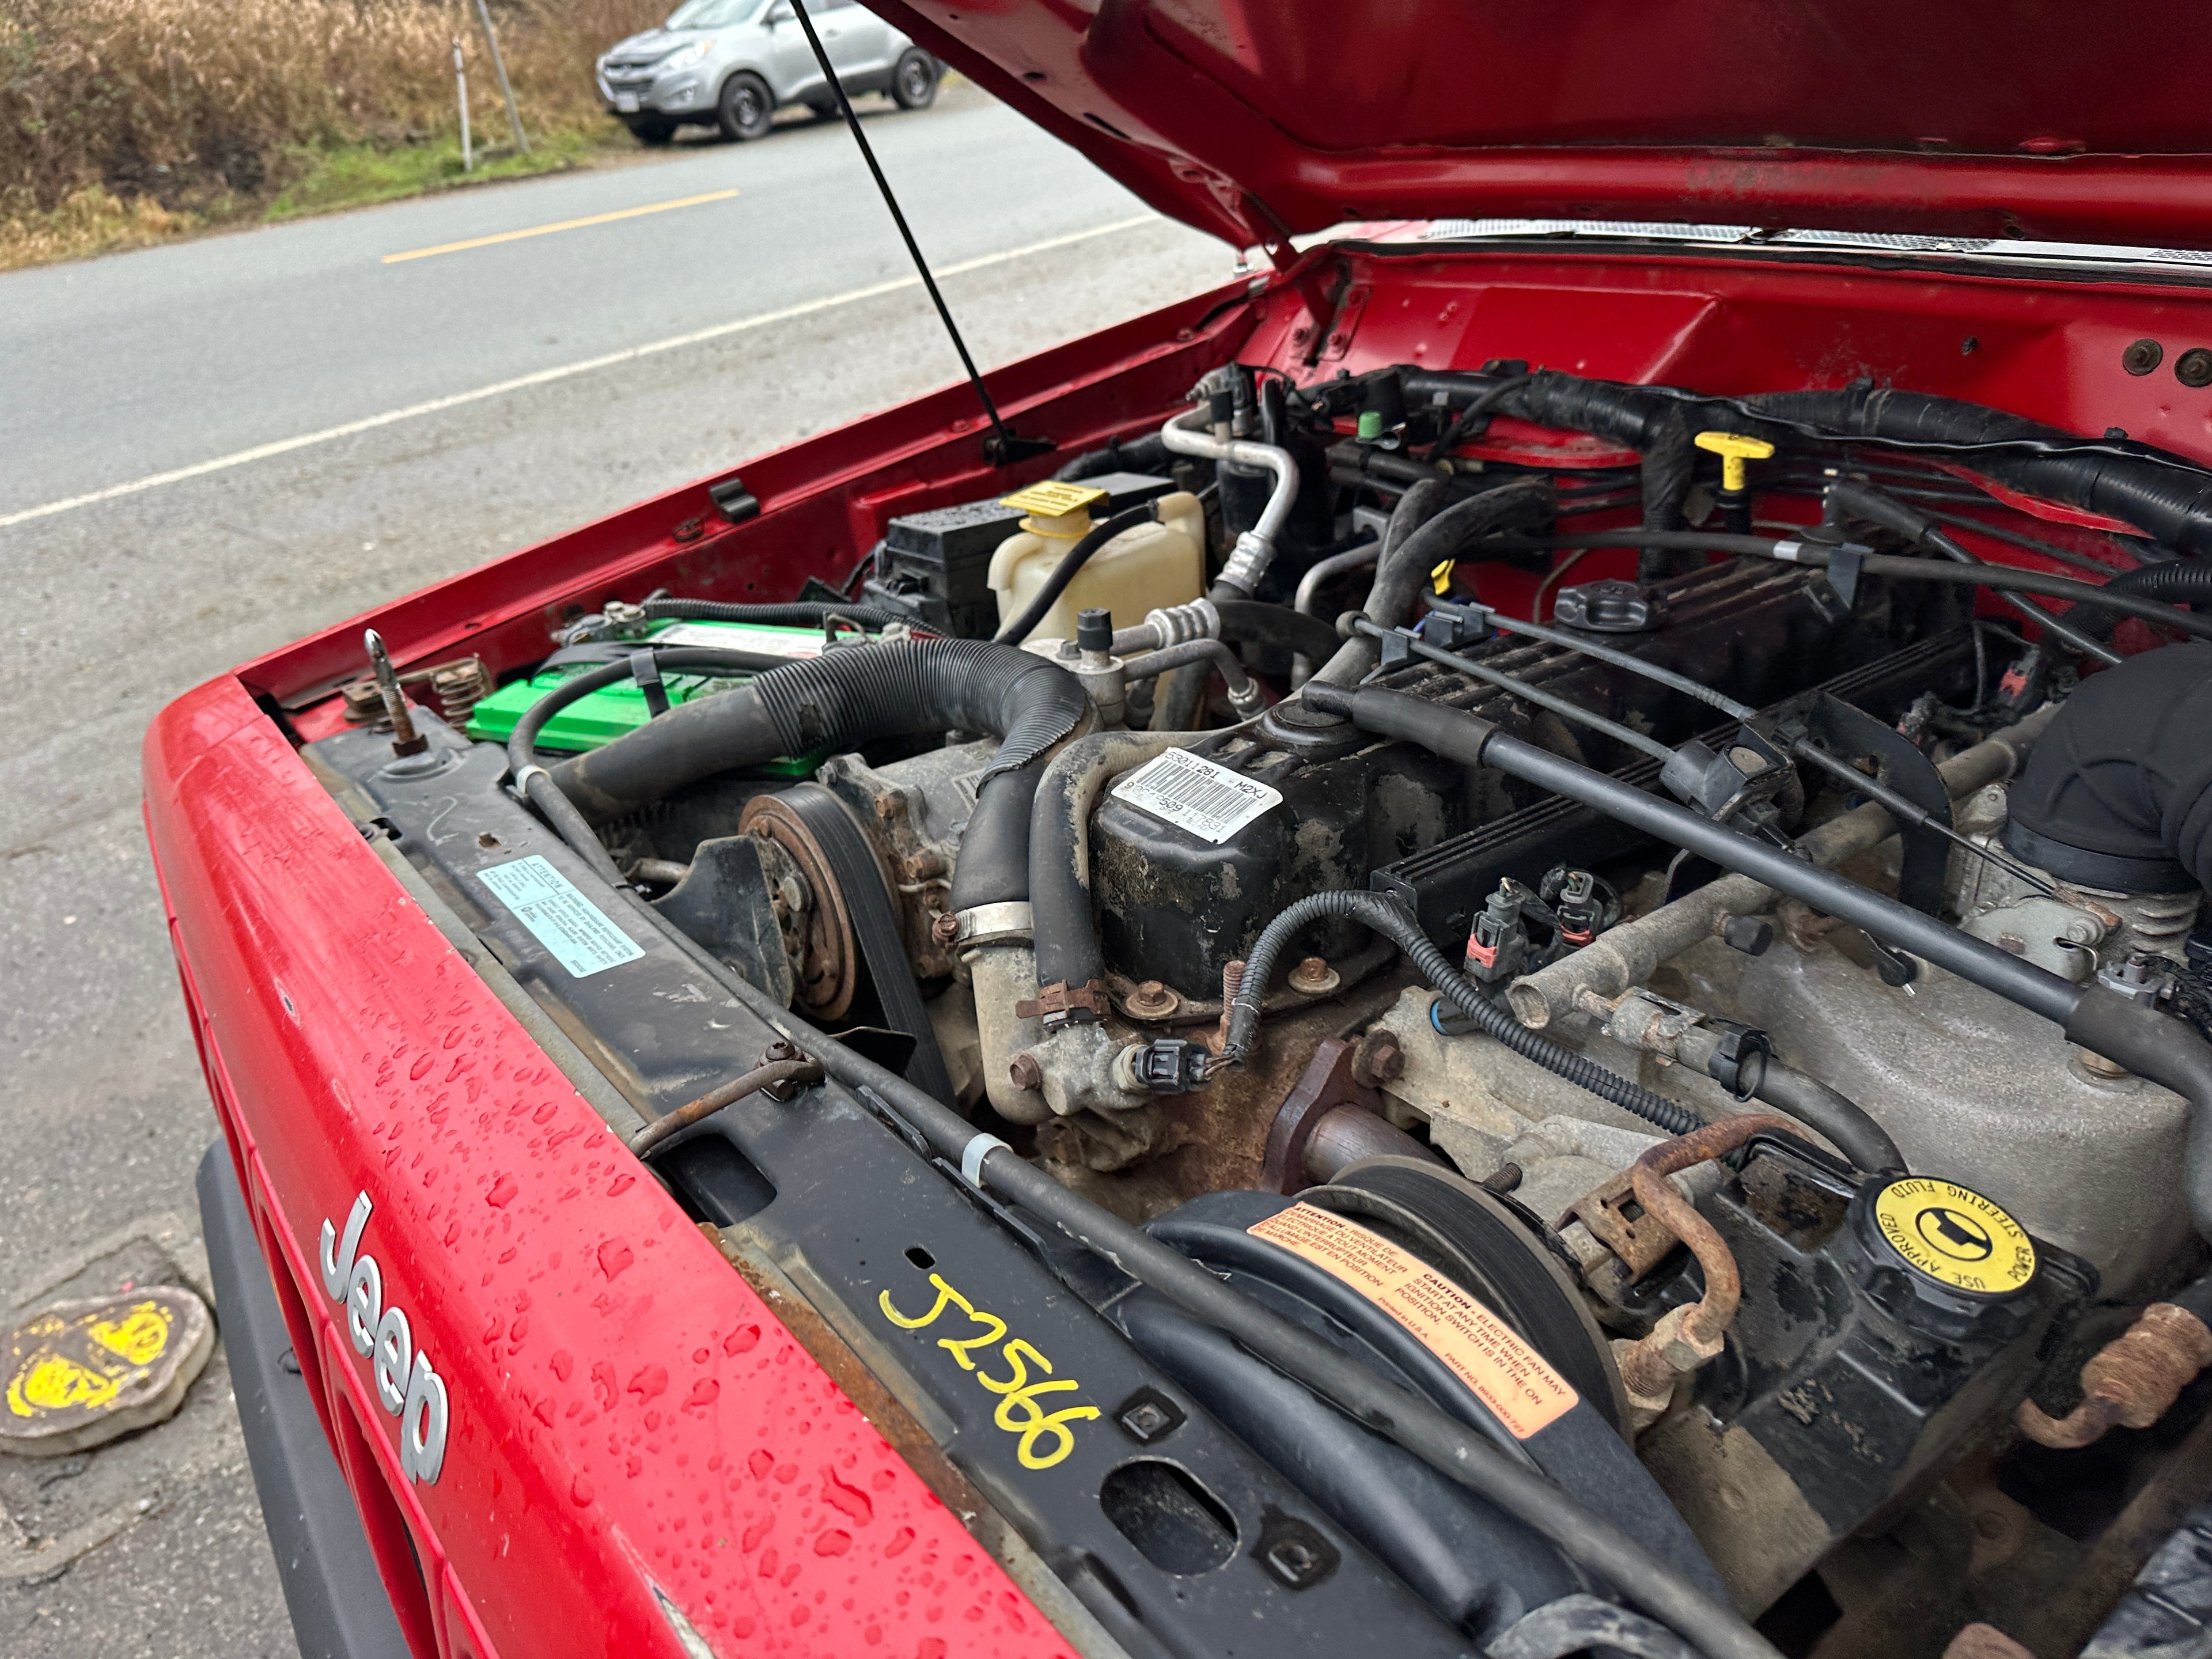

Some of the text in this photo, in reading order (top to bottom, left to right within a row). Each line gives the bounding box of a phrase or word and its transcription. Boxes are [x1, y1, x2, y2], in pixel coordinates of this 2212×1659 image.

[1165, 752, 1268, 800] 53011281 M2XJ
[532, 862, 563, 888] ATTENTION
[1278, 1214, 1328, 1236] ELECTRIQUE
[1334, 1237, 1358, 1250] TOUT
[1356, 1250, 1397, 1274] MOMENT
[1286, 1210, 1408, 1273] DEMARRAGE DU VENTILATEUR
[1294, 1207, 1345, 1228] ATTENTION
[1350, 1230, 1384, 1248] RISQUE
[1382, 1247, 1399, 1256] DE
[1297, 1229, 1368, 1266] L'INTERRUPTEUR
[1880, 1213, 1986, 1289] USE APPROVED
[1891, 1181, 2032, 1282] POWER STEERING FLUID
[1309, 1242, 1330, 1252] EST
[1326, 1251, 1342, 1260] EN
[1339, 1258, 1384, 1286] POSITION
[1378, 1297, 1402, 1316] Printed
[1413, 1278, 1531, 1377] START AT ANY TIME WHEN
[1423, 1274, 1471, 1309] CAUTION
[1476, 1314, 1524, 1356] ELECTRIC
[1523, 1356, 1545, 1376] FAN
[1543, 1375, 1566, 1395] MAY
[319, 1190, 449, 1485] Jeep
[1404, 1283, 1543, 1405] IGNITION SWITCH IS IN THE ON
[1445, 1353, 1466, 1371] PART
[879, 1273, 1101, 1469] J2566
